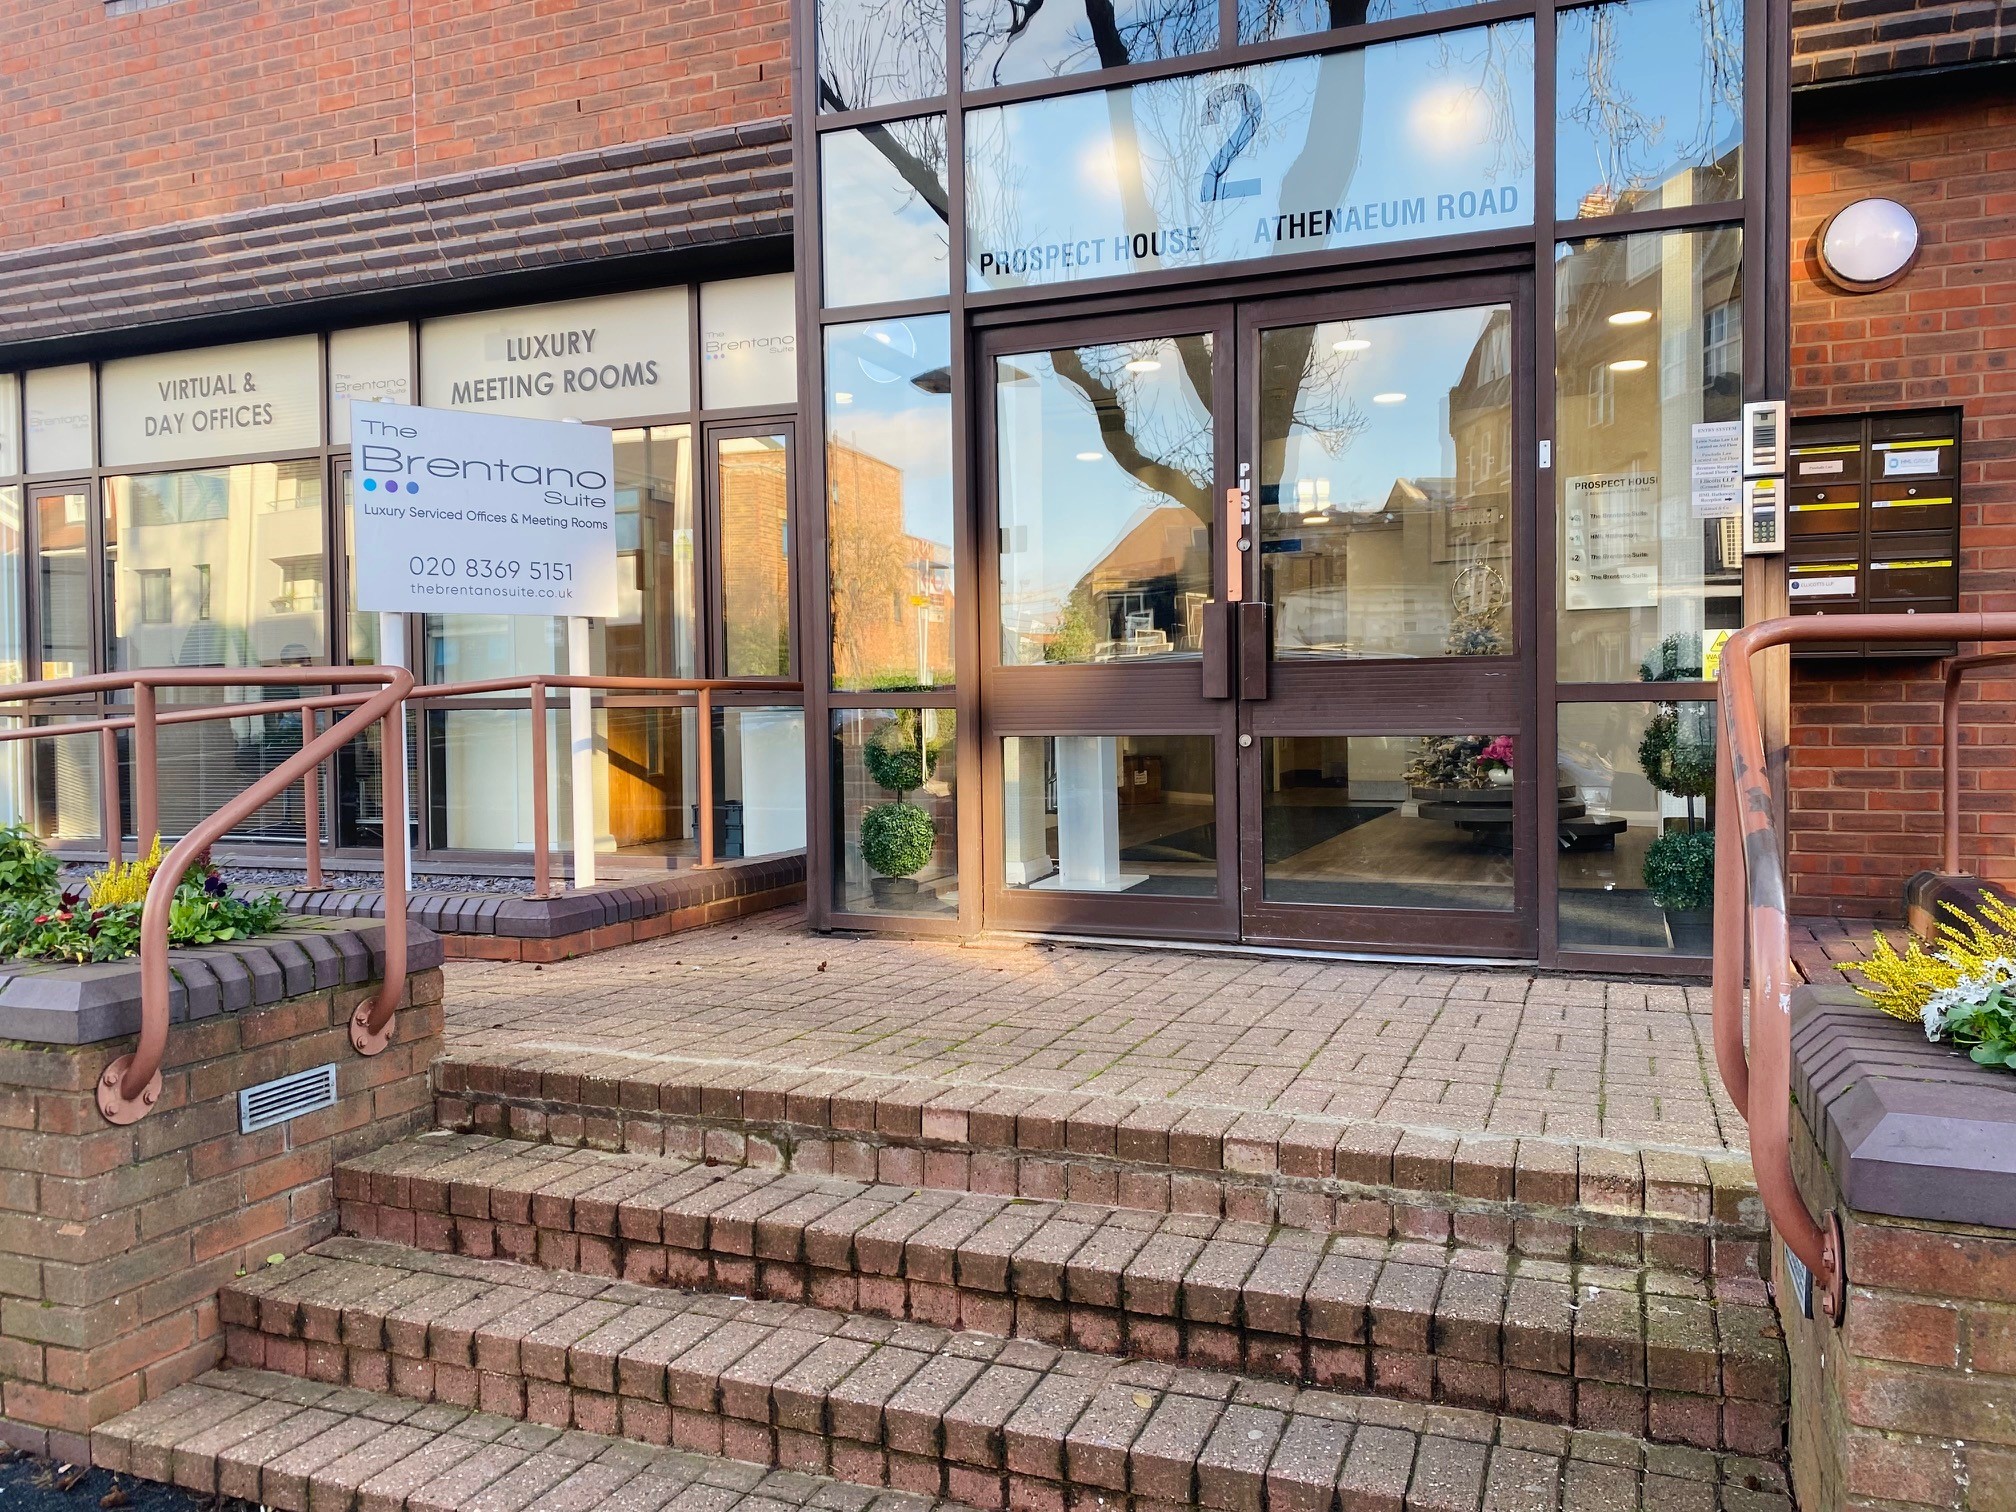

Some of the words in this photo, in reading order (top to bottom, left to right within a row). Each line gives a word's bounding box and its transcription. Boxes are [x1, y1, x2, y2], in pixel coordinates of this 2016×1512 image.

[1200, 82, 1262, 203] 2
[1253, 197, 1425, 244] ATHENAEUM
[1437, 185, 1518, 221] ROAD
[980, 238, 1106, 277] PROSPECT
[1114, 226, 1200, 261] HOUSE
[507, 329, 596, 361] LUXURY
[706, 336, 794, 352] Brentano
[158, 374, 236, 401] VIRTUAL
[243, 372, 256, 392] &
[336, 379, 406, 392] Brentano
[451, 372, 554, 404] MEETING
[564, 360, 658, 393] ROOMS
[30, 414, 89, 427] Brentano
[145, 413, 184, 436] DAY
[192, 403, 272, 431] OFFICES
[361, 420, 417, 438] The
[362, 445, 606, 490] Brentano
[1240, 463, 1250, 525] PUSH
[1575, 479, 1625, 490] PROSPECT
[544, 491, 606, 508] Suite
[364, 504, 405, 519] Luxury
[409, 507, 463, 520] Serviced
[466, 510, 506, 523] Offices
[511, 514, 518, 524] &
[522, 514, 568, 529] Meeting
[572, 518, 608, 530] Rooms
[409, 556, 456, 576] 020
[466, 558, 520, 579] 8369
[530, 562, 572, 580] 5151
[411, 583, 572, 599] thebrentanosuite.co.uk
